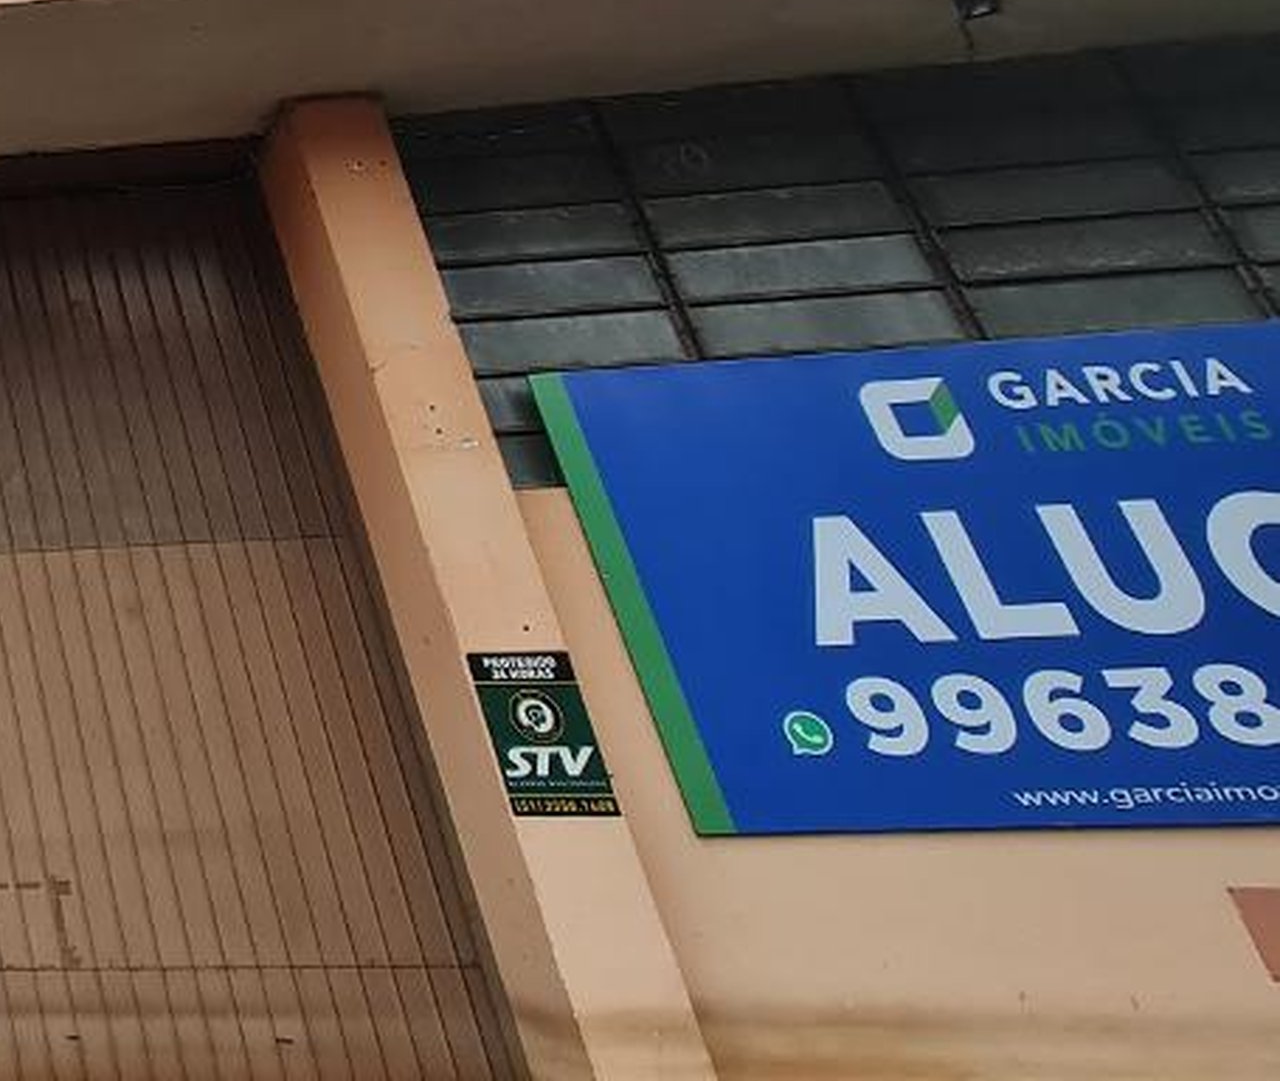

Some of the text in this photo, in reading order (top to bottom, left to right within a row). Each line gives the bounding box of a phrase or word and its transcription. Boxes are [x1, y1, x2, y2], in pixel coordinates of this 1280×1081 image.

[987, 358, 1253, 409] GARCIA
[1016, 410, 1272, 452] IMÓVEIS
[845, 663, 1280, 757] 99638
[505, 746, 594, 777] STV
[1013, 782, 1280, 809] www.garciaimo
